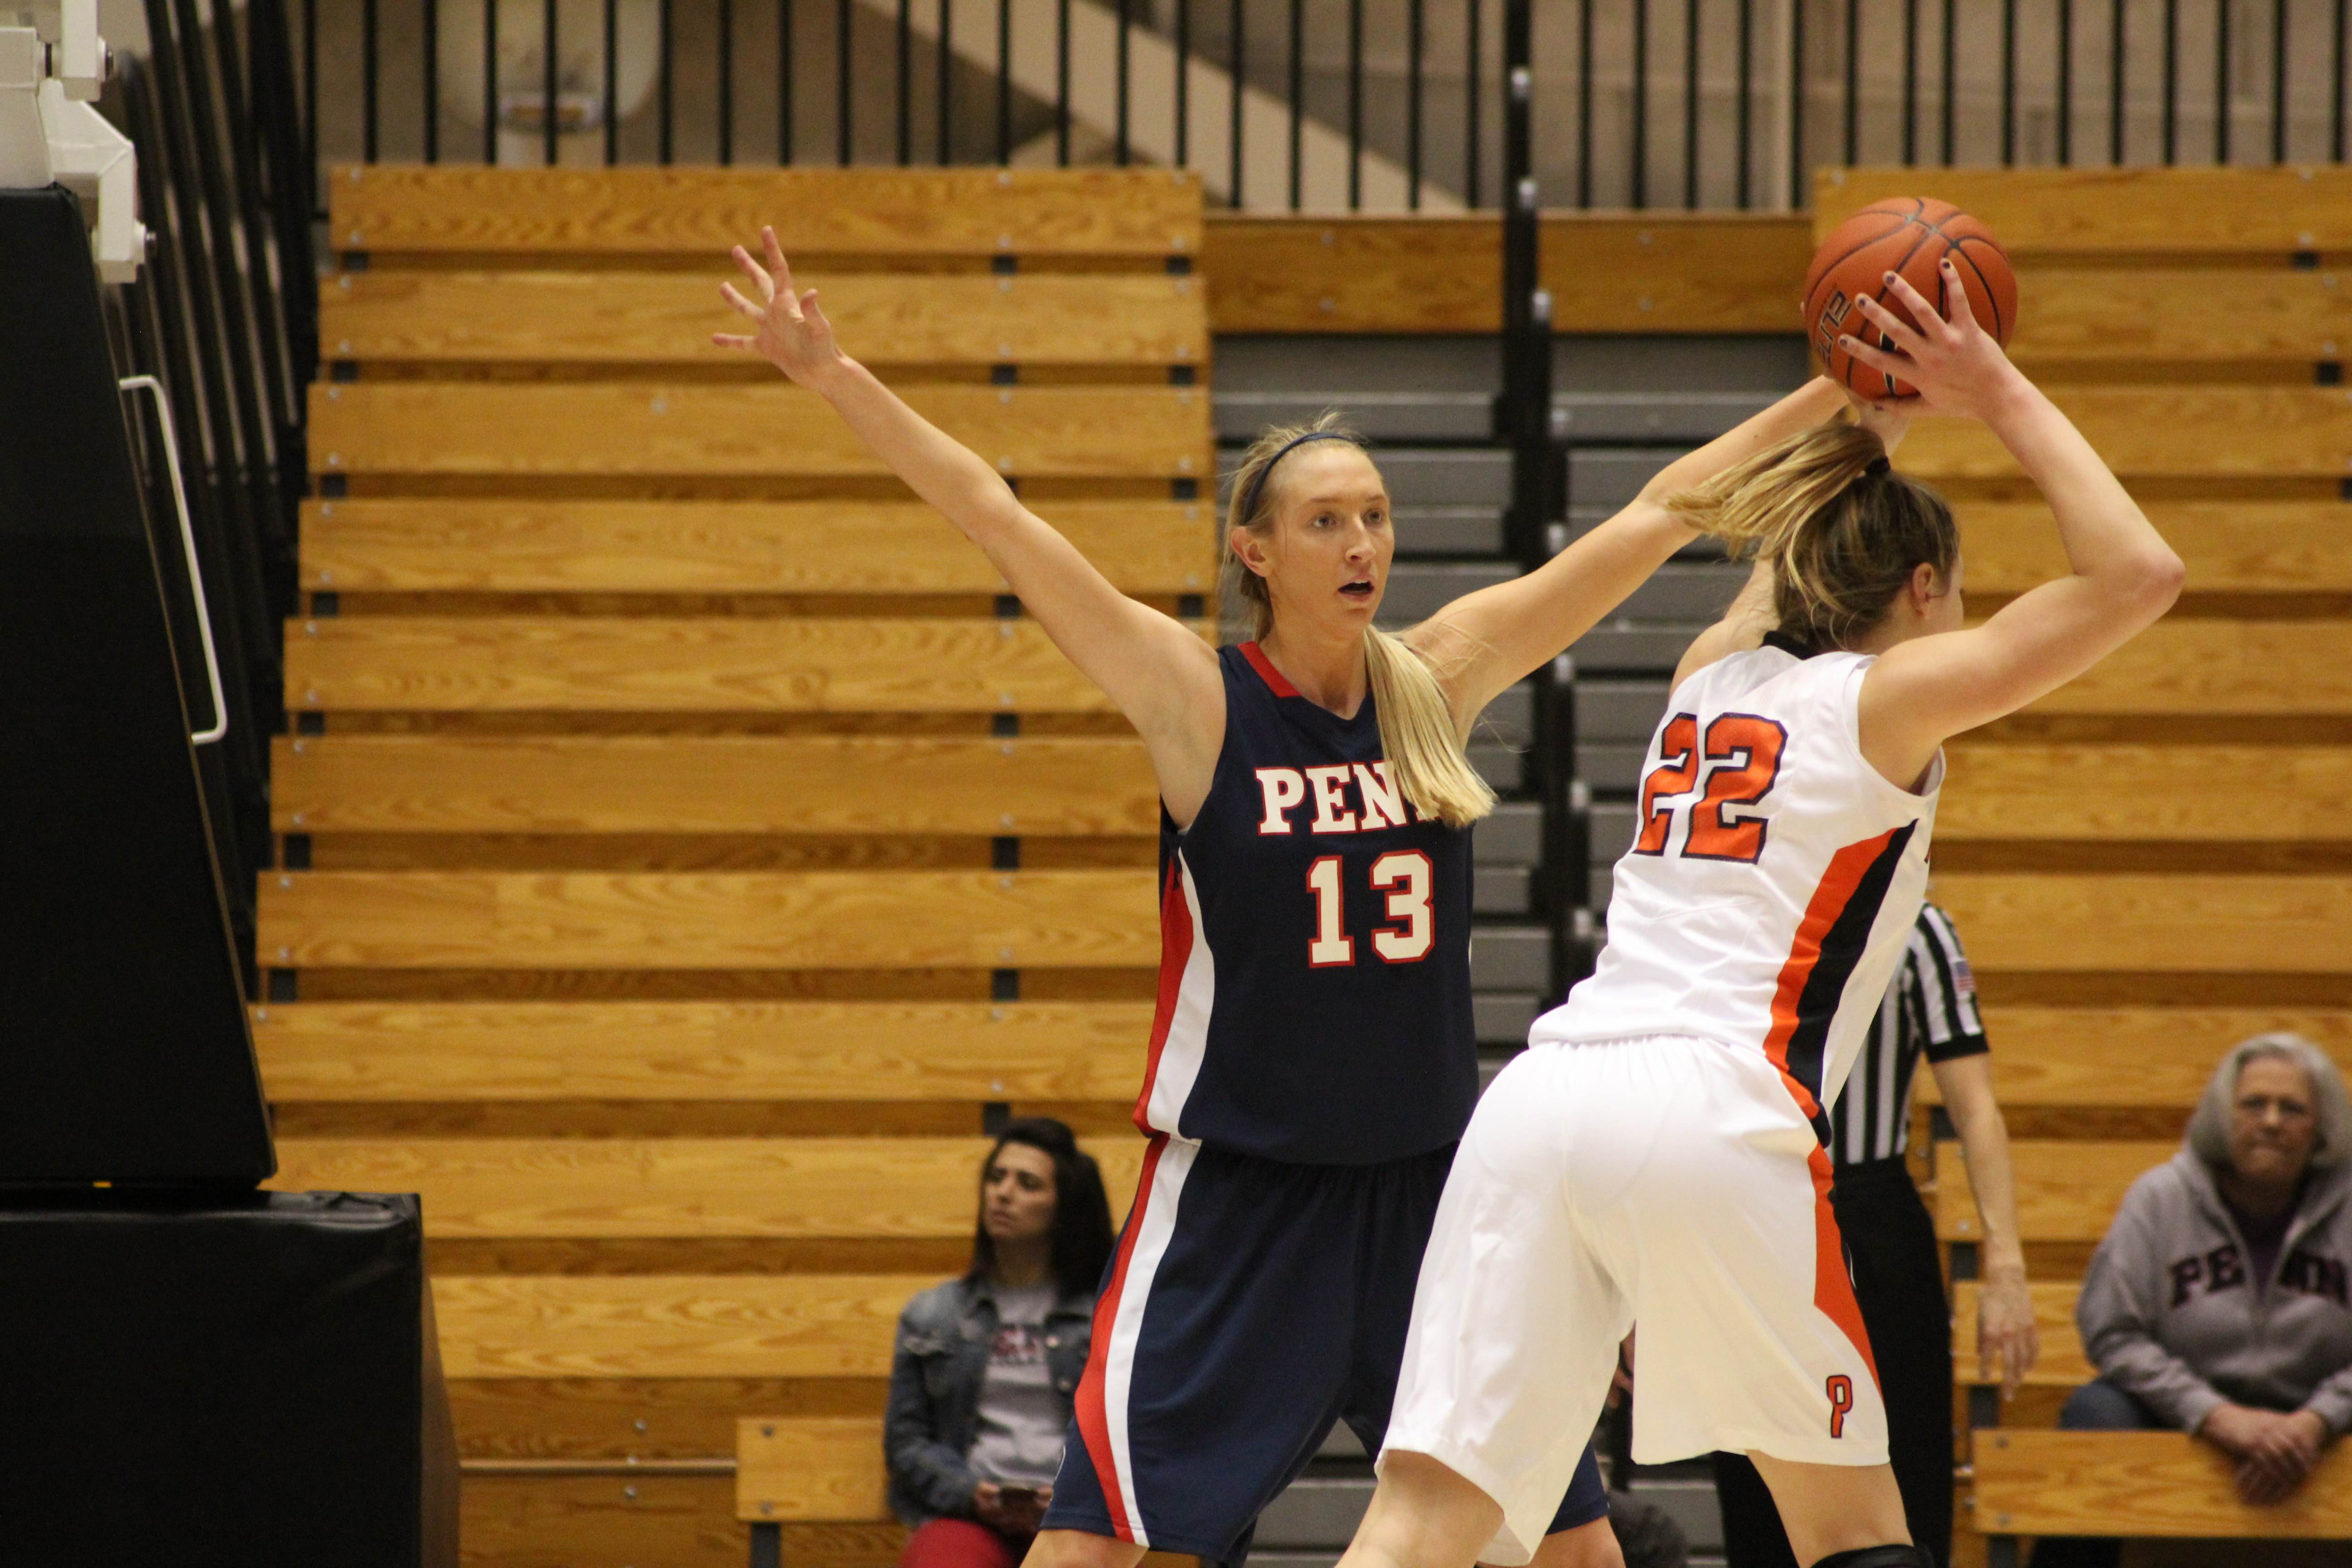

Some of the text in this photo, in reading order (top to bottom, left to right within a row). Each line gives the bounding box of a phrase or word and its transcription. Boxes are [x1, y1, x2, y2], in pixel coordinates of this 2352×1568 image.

[1254, 760, 1441, 835] PEN
[1631, 712, 1788, 865] 22
[1306, 849, 1435, 968] 13
[1826, 1374, 1853, 1439] P
